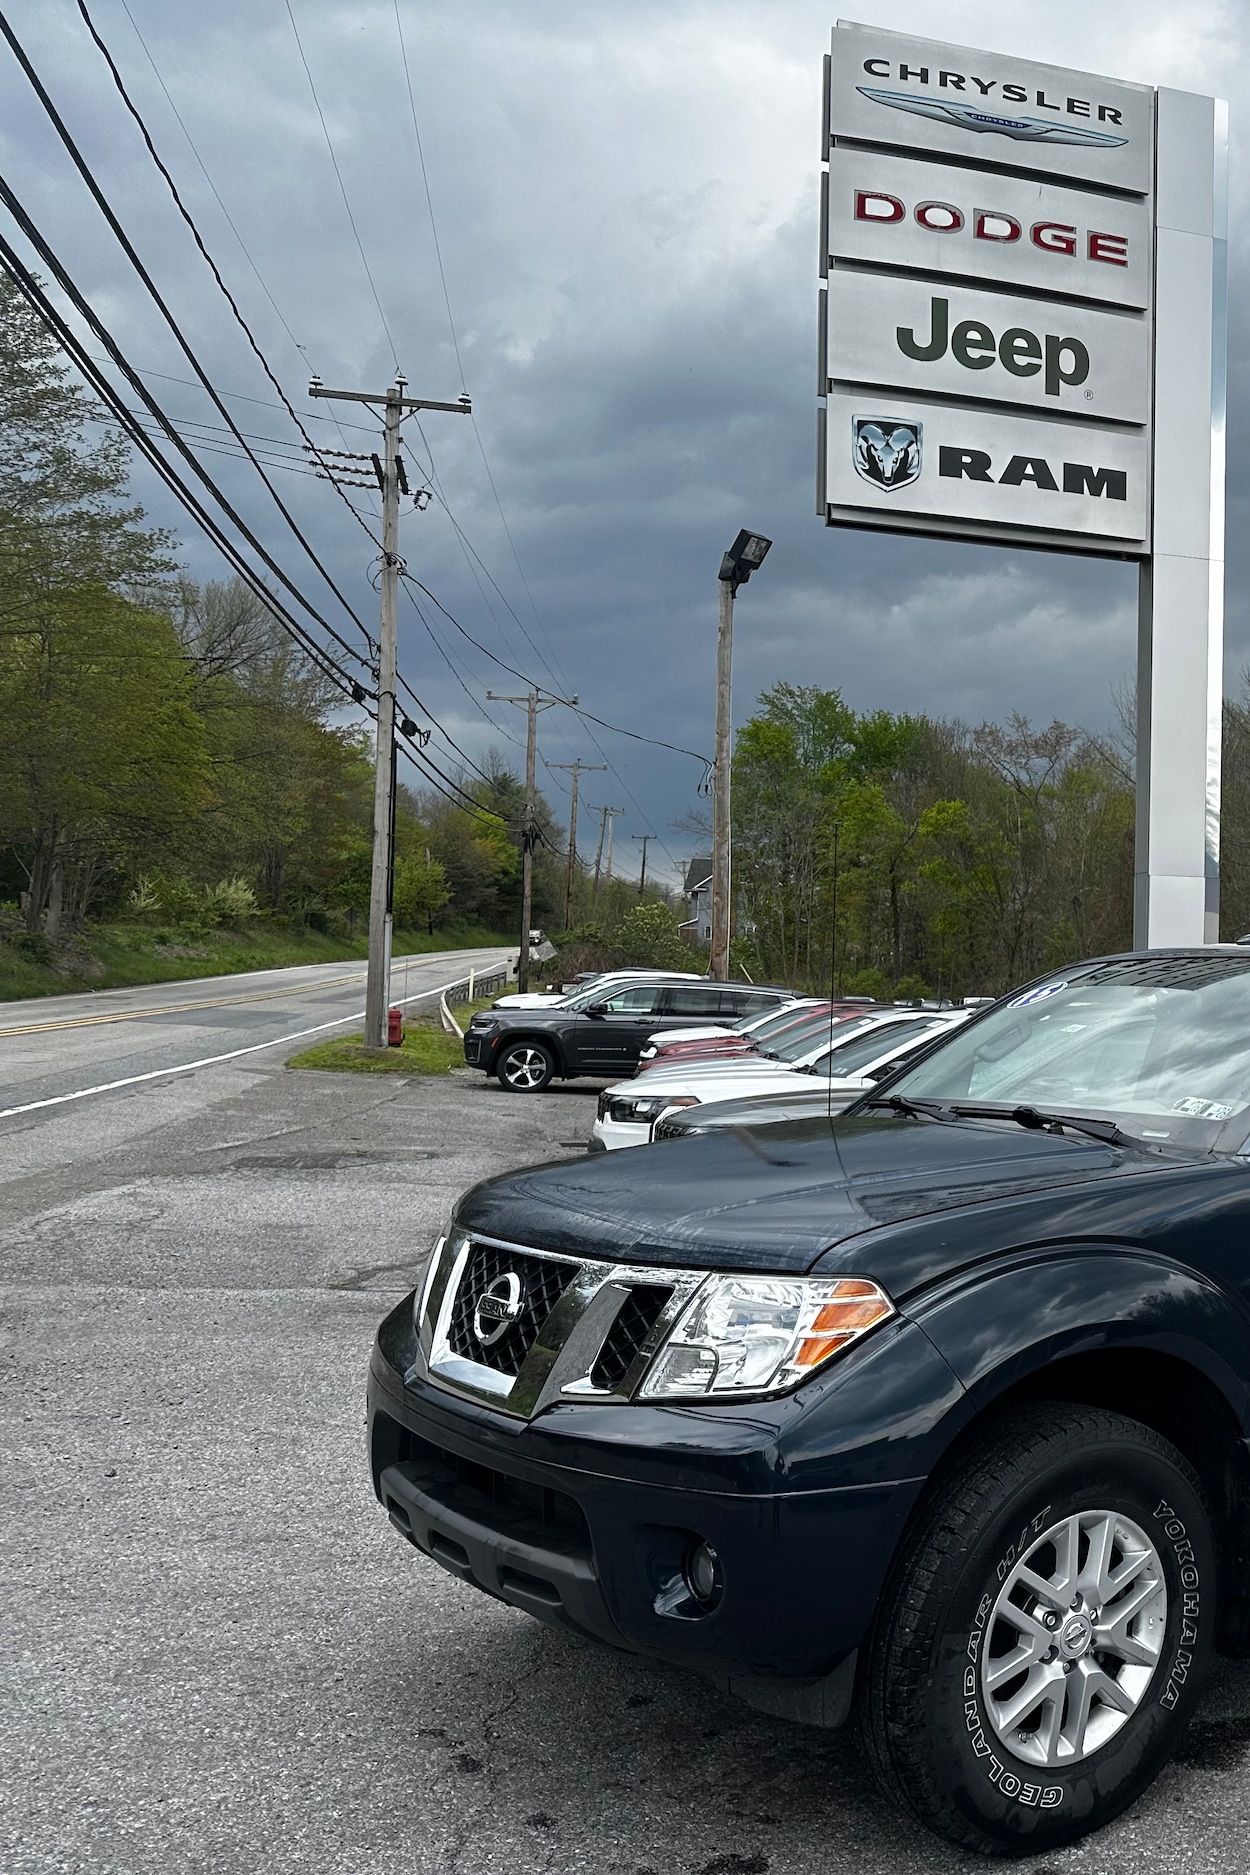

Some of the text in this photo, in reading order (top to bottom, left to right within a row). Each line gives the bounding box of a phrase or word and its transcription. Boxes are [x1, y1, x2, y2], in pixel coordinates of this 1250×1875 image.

[863, 58, 1124, 126] CHRYSLER
[853, 188, 1129, 268] DODGE
[896, 296, 1090, 396] Jeep
[938, 445, 1127, 501] RAM
[1153, 1499, 1200, 1710] YOKOHAMA
[963, 1593, 1065, 1809] GEOLANDAR
